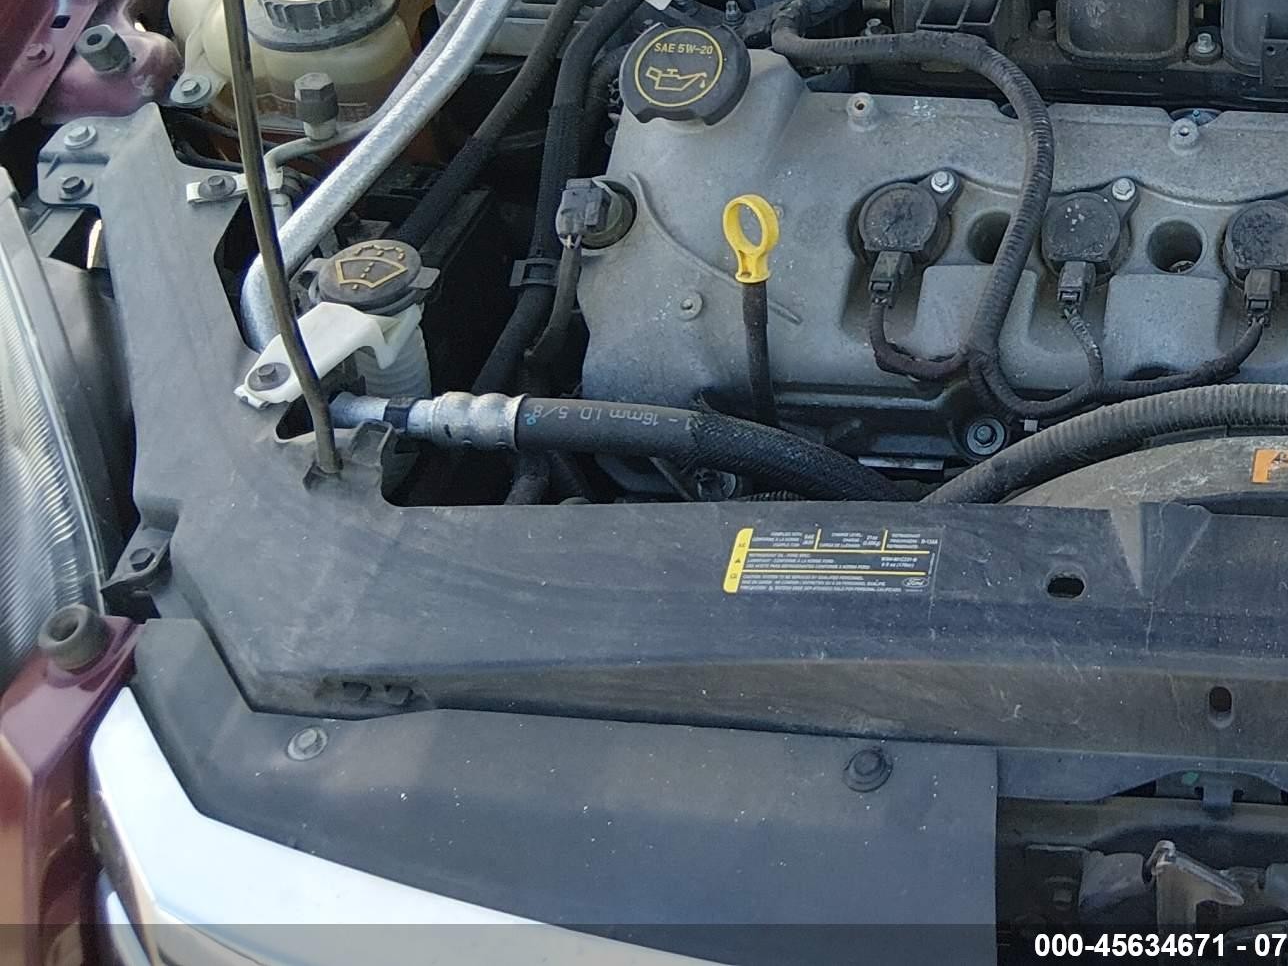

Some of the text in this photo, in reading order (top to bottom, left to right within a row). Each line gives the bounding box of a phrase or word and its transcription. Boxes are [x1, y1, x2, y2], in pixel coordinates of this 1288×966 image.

[654, 42, 713, 55] SAE 5W-20
[609, 409, 659, 426] 16mm
